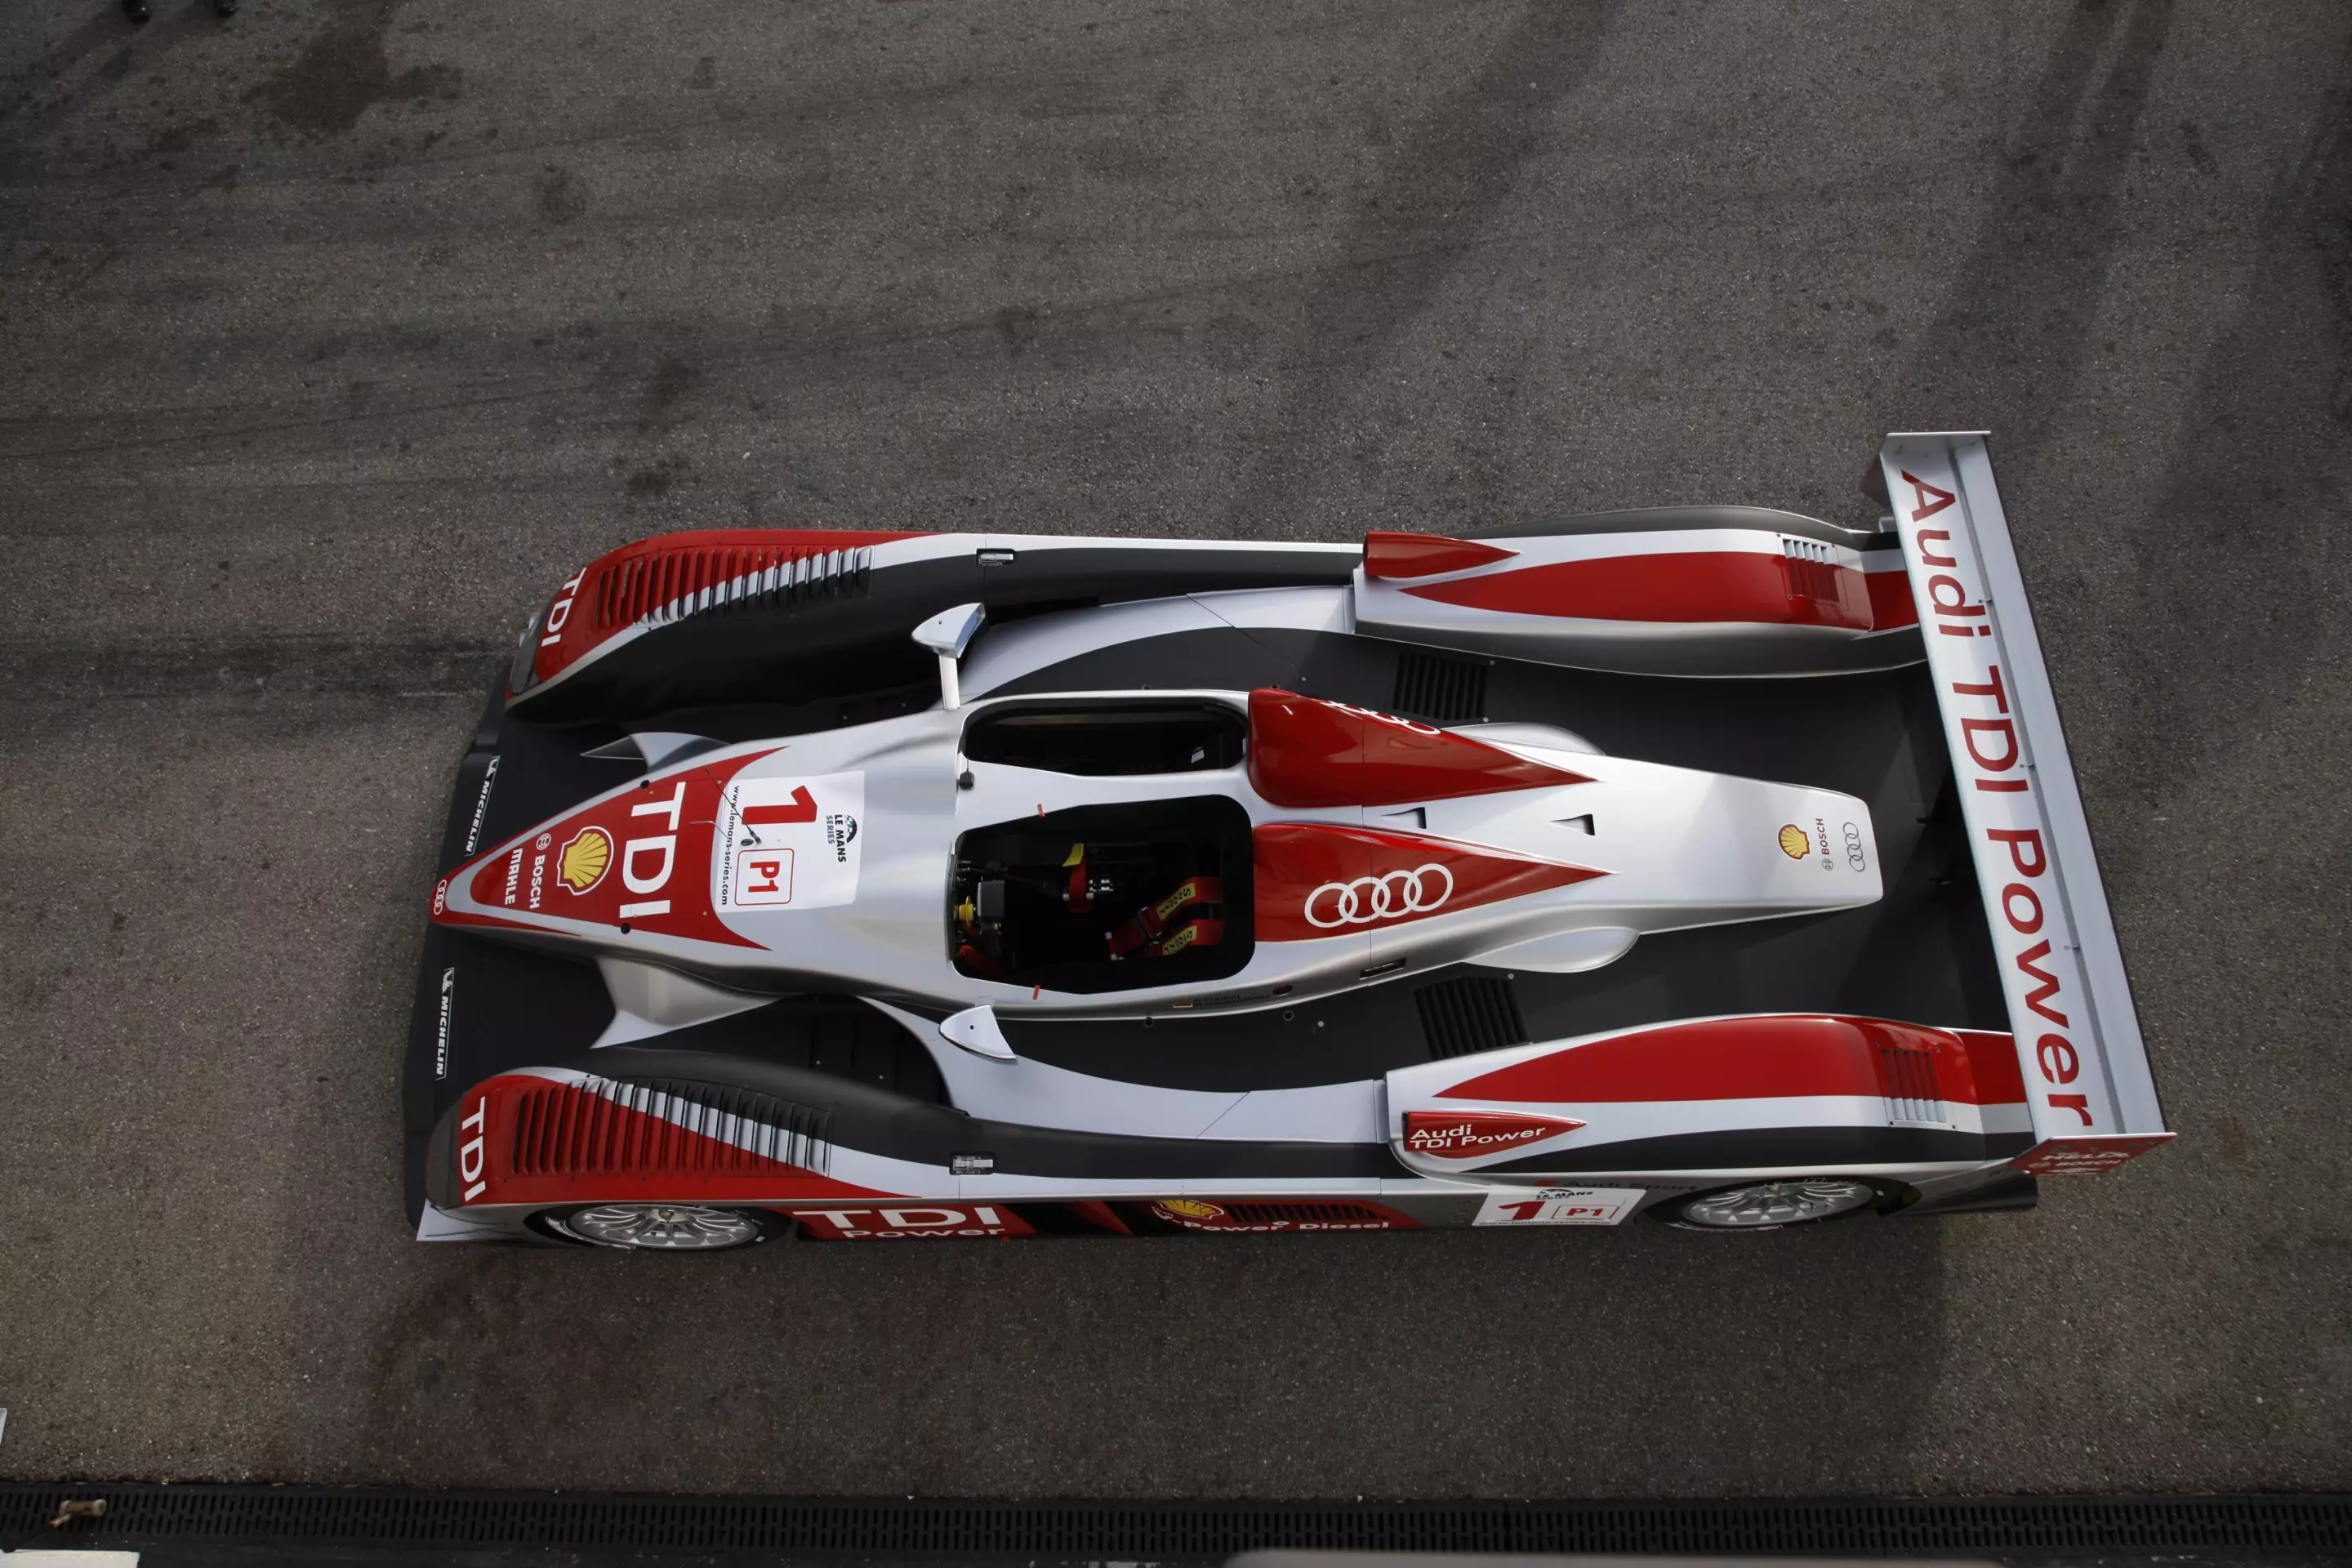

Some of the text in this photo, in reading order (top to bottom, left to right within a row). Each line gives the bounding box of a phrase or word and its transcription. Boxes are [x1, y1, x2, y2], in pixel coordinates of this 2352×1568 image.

[1900, 470, 1991, 637] Audi
[541, 567, 586, 647] TDI
[1952, 665, 2029, 792] TDI
[466, 781, 490, 853] MICHELIN
[742, 785, 817, 825] 1
[620, 782, 686, 918] TDI
[720, 786, 740, 905] www.lemans-series.com
[826, 815, 835, 844] SERIES
[835, 814, 846, 862] LE MANS
[1815, 818, 1830, 855] BOSCH
[505, 848, 523, 905] MAHLE
[529, 855, 546, 908] BOSCH
[748, 861, 781, 893] P1
[1987, 828, 2093, 1127] Power
[436, 996, 448, 1075] MICHELIN
[461, 1096, 486, 1202] TDI
[1410, 1124, 1472, 1140] Audi
[1410, 1127, 1545, 1149] TDI Power
[792, 1207, 1001, 1228] TDI
[842, 1229, 1005, 1238] Power
[1299, 1222, 1390, 1230] Diesel
[1498, 1200, 1546, 1221] 1
[1566, 1207, 1605, 1217] P1
